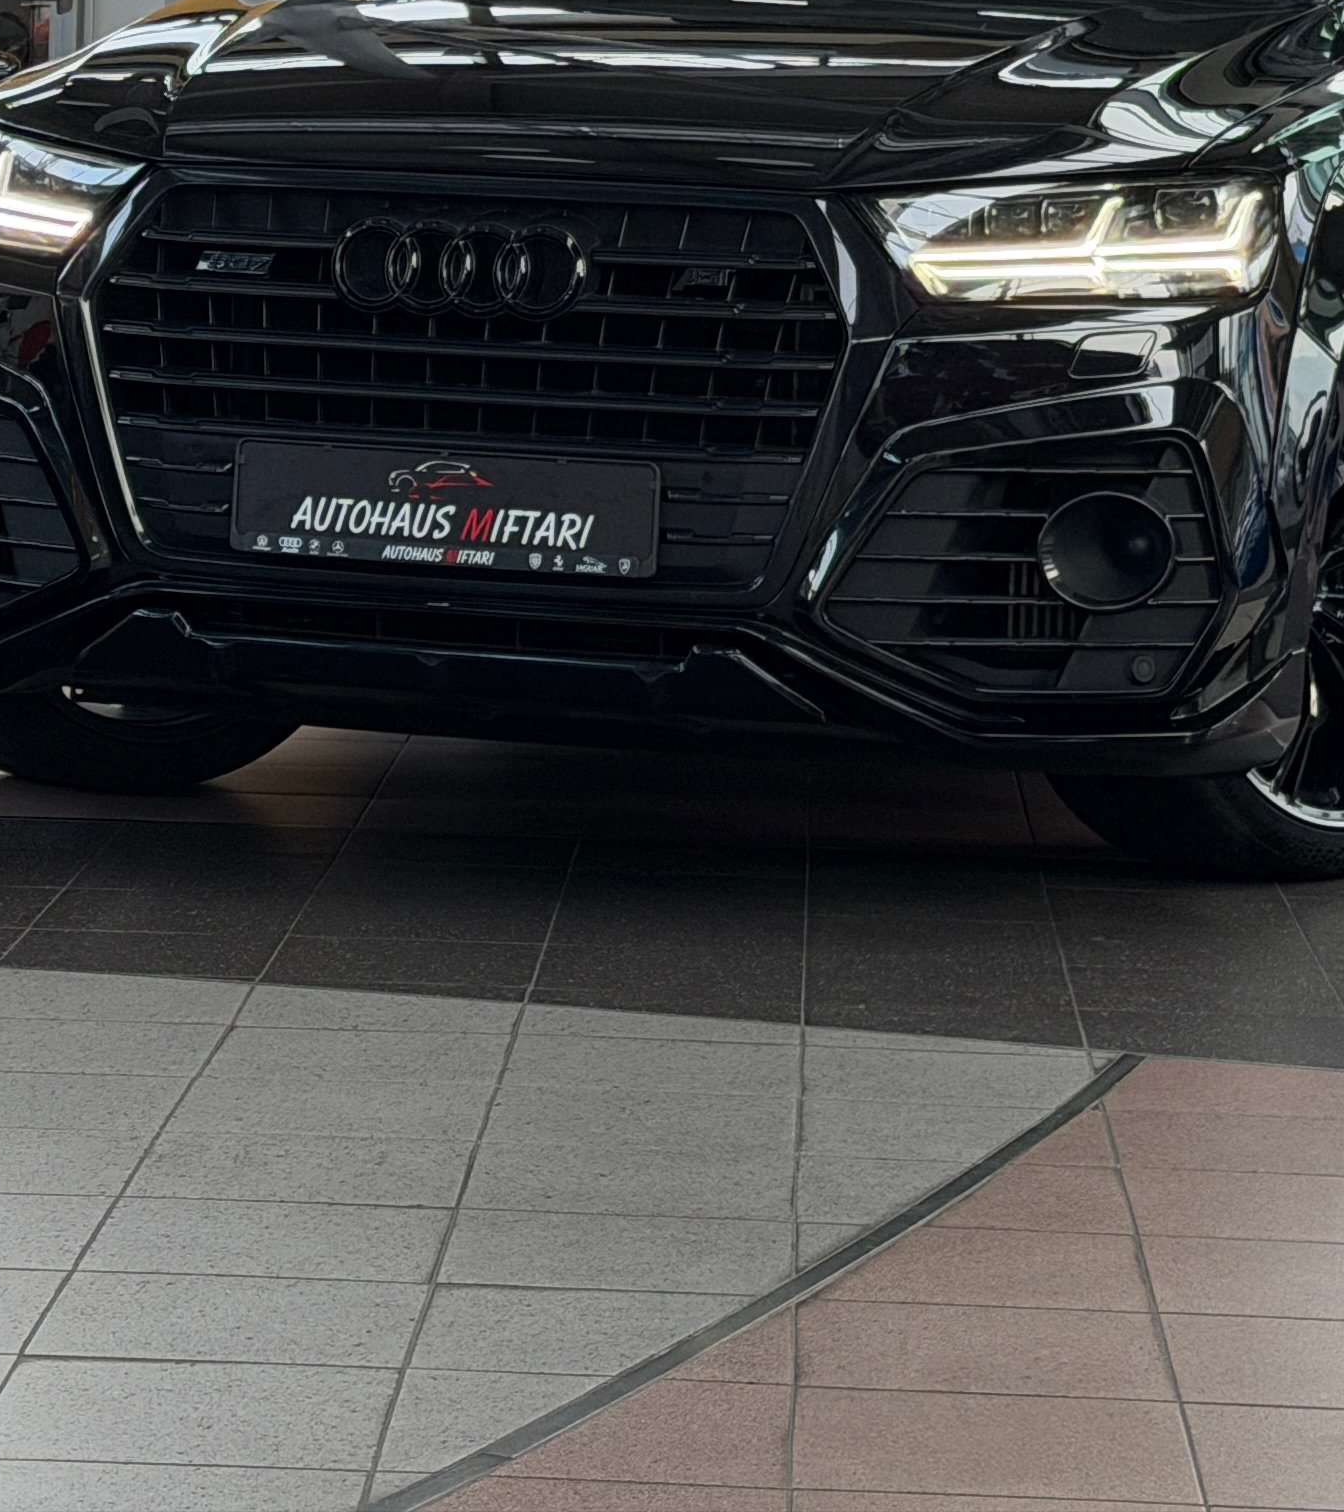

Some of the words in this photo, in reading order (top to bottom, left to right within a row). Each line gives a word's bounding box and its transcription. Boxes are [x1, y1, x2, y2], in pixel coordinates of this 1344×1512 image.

[290, 496, 456, 540] AUTOHAUS
[460, 507, 595, 551] MIFTARI
[382, 545, 444, 563] AUTOHAUS
